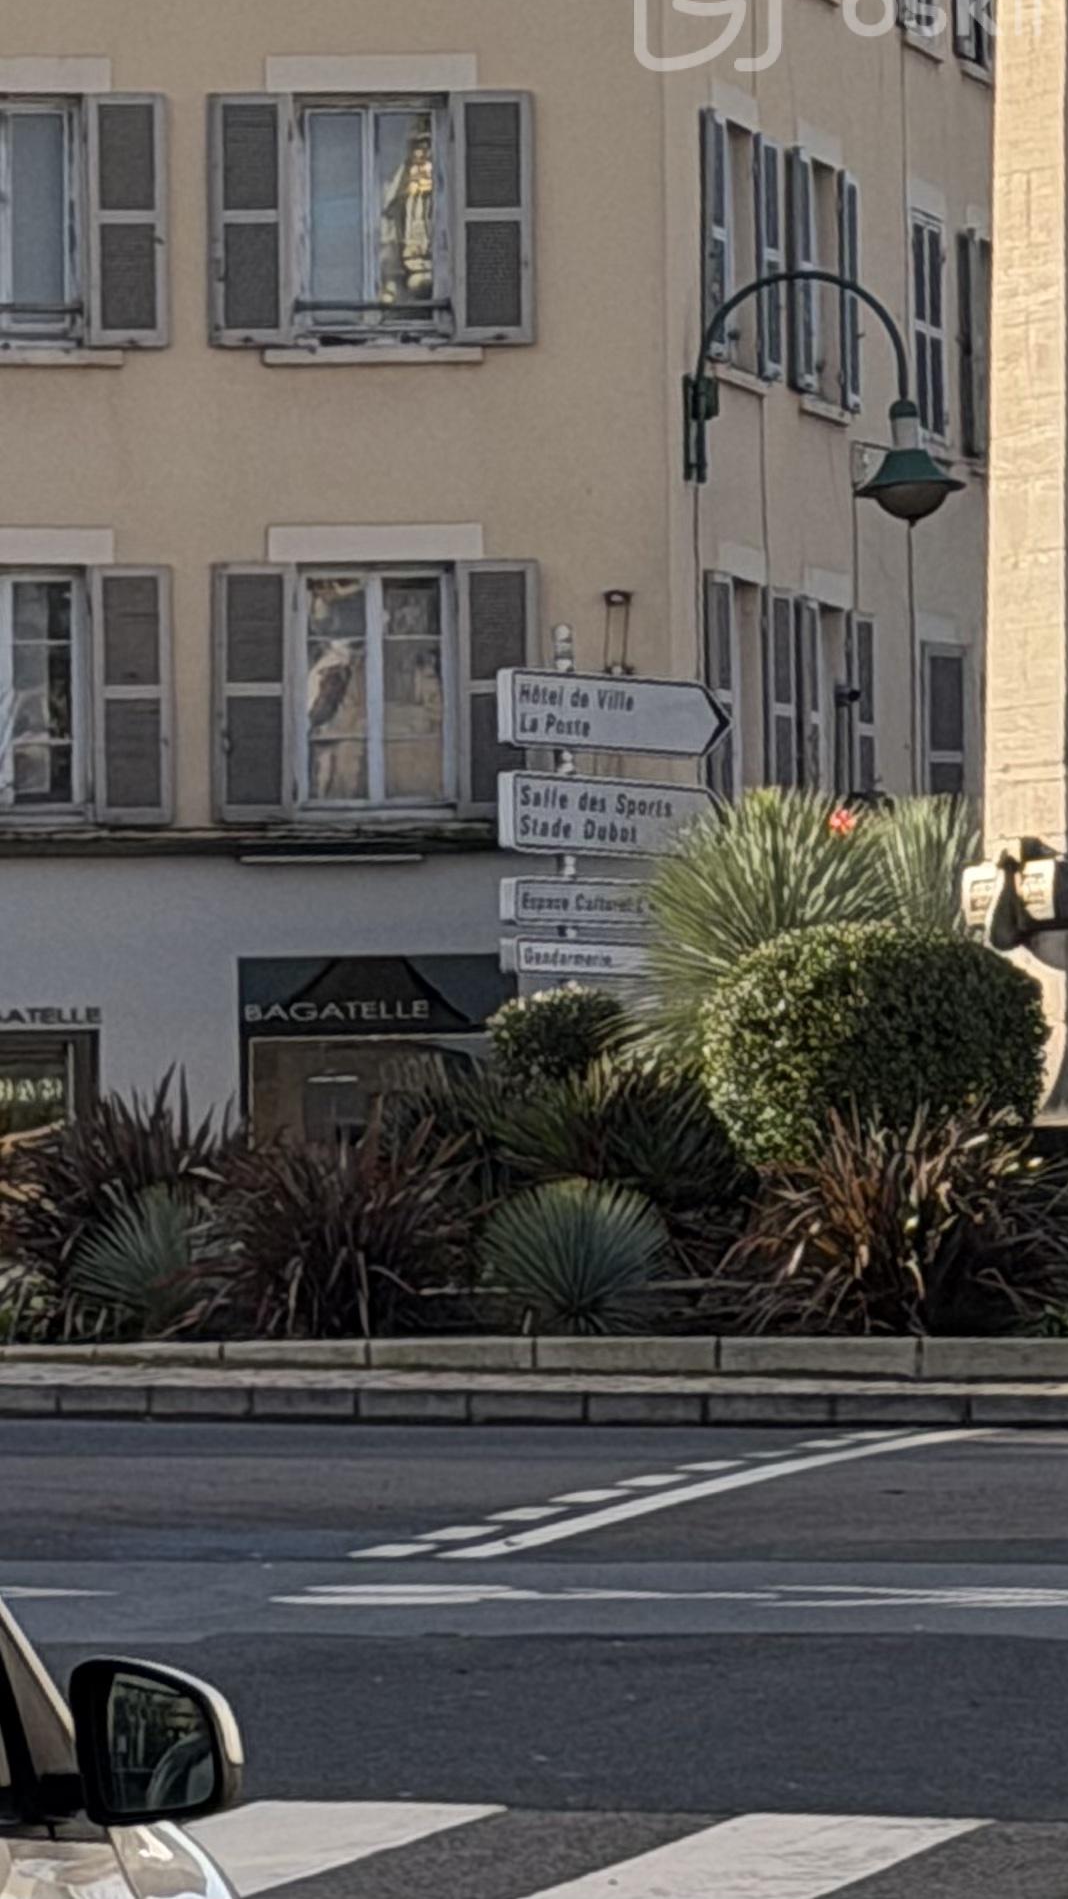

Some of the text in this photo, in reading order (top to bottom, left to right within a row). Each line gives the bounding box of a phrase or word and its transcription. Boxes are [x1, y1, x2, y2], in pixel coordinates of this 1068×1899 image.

[519, 684, 634, 712] Hôtel de Ville
[519, 713, 590, 737] La Poste
[520, 784, 673, 818] Salle des Sports
[520, 814, 572, 839] Stade
[524, 946, 612, 967] Gendarmerie
[0, 1006, 102, 1025] ATELLE
[244, 1000, 429, 1022] BAGATELLE
